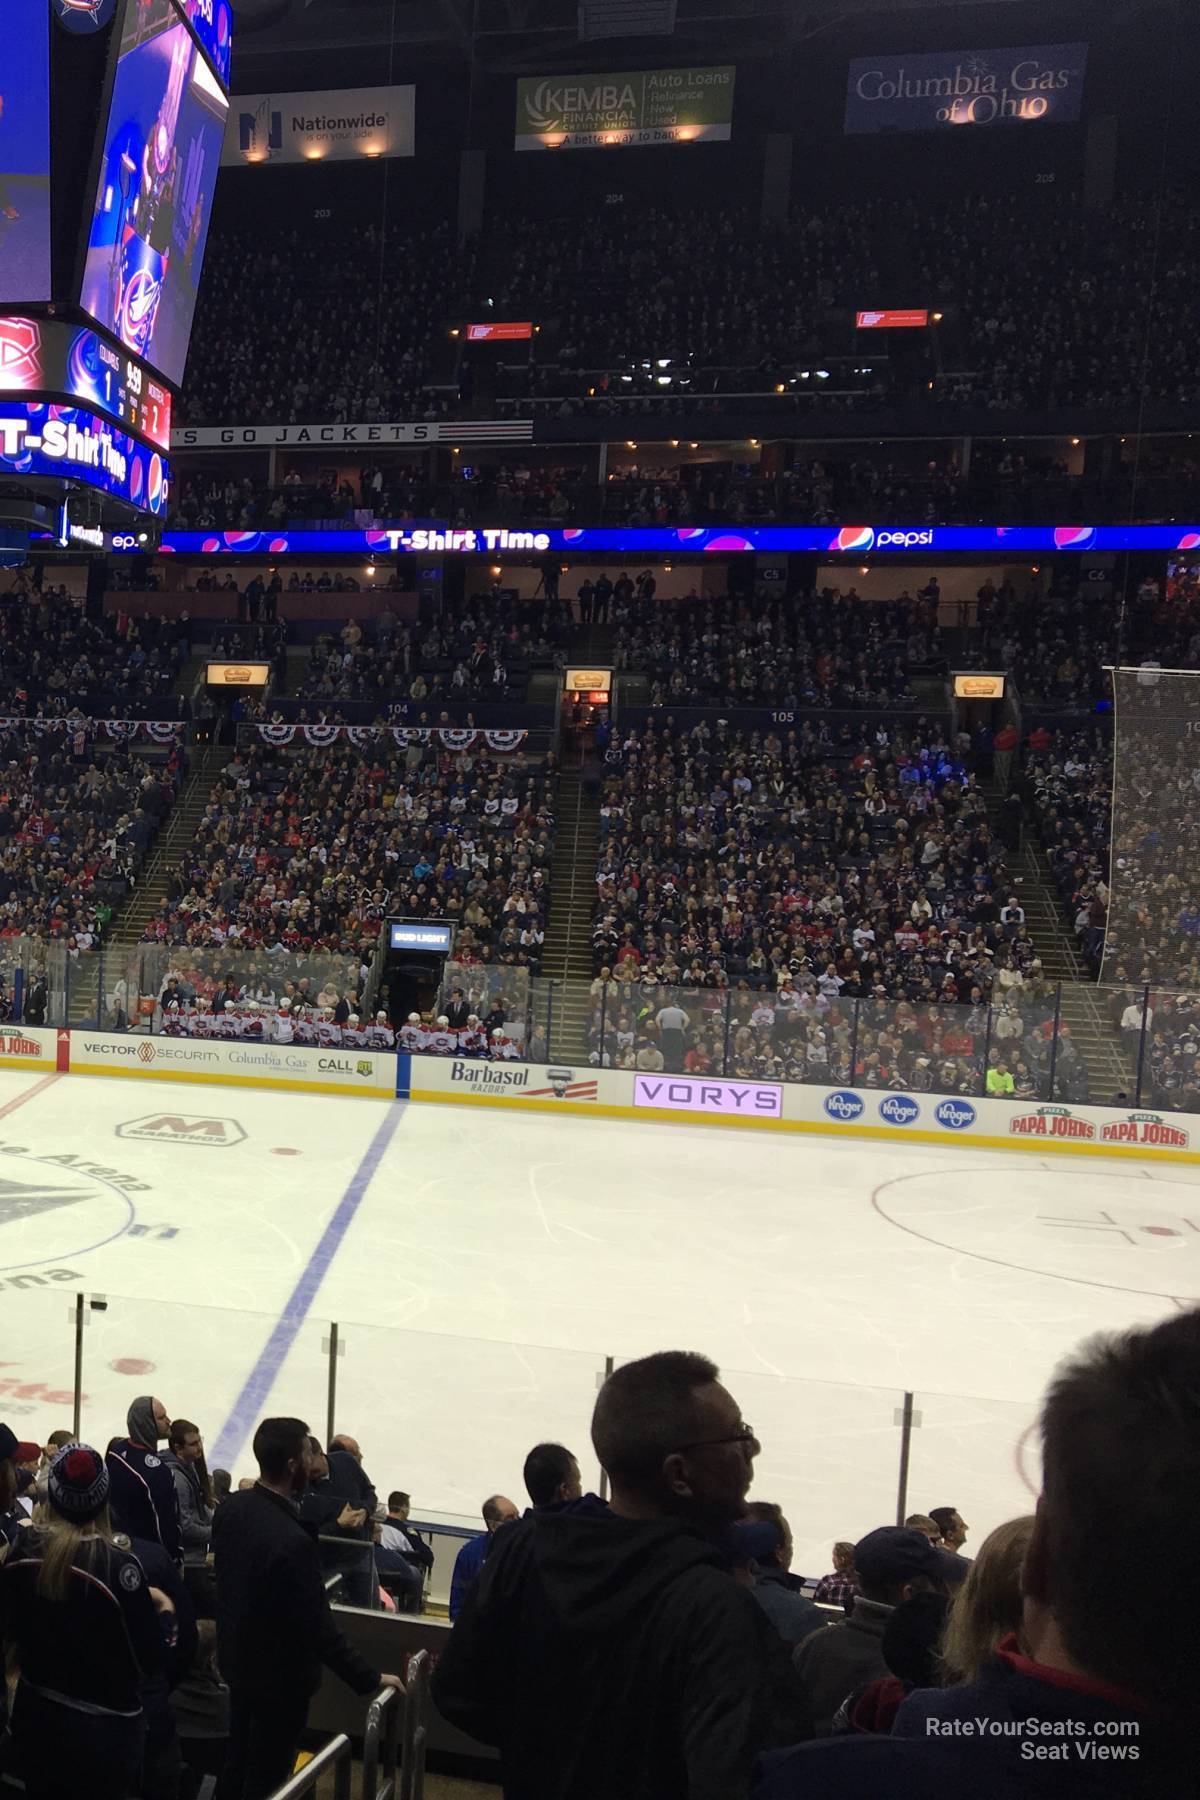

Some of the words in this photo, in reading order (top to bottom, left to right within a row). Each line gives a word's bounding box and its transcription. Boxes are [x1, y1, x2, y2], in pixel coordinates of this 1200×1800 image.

[649, 74, 682, 89] Auto
[688, 71, 730, 86] Loans
[856, 65, 998, 101] Columbia
[1011, 61, 1069, 92] Gas
[546, 84, 636, 113] KEMBA
[936, 98, 964, 122] of
[968, 88, 1048, 125] Ohio
[292, 113, 386, 132] Nationwide
[563, 111, 636, 123] FINANCIAL
[604, 120, 636, 130] UNION
[652, 115, 677, 125] Used
[316, 133, 329, 141] on
[330, 132, 351, 142] your
[354, 130, 373, 139] side
[563, 135, 571, 145] A
[575, 132, 608, 144] better
[639, 132, 650, 142] to
[654, 129, 681, 141] bank
[314, 209, 330, 218] 203
[126, 361, 142, 394] 9:59
[105, 371, 111, 401] 1
[152, 406, 158, 434] 2
[221, 429, 257, 443] GO
[275, 426, 428, 443] JACKETS
[101, 430, 126, 482] Time
[386, 530, 476, 551] T-Shirt
[483, 529, 550, 550] Time
[877, 529, 933, 547] pepsi
[764, 569, 780, 580] C5
[1088, 569, 1105, 582] C6
[388, 704, 409, 714] 104
[772, 711, 794, 723] 105
[83, 1041, 136, 1055] VECTOR
[157, 1048, 220, 1062] SECURITY
[228, 1051, 281, 1067] Columbia
[286, 1055, 308, 1068] Gas
[318, 1058, 353, 1071] CALL
[451, 1062, 529, 1086] Barbasol
[471, 1084, 505, 1094] RAZORS
[640, 1081, 777, 1110] VORYS
[828, 1094, 862, 1118] Kroger
[882, 1096, 918, 1121] Kroger
[938, 1102, 974, 1127] Kroger
[1012, 1115, 1047, 1135] PAPA
[1103, 1123, 1138, 1143] PAPA
[127, 1129, 228, 1144] MARATHON
[36, 1153, 153, 1192] Arena
